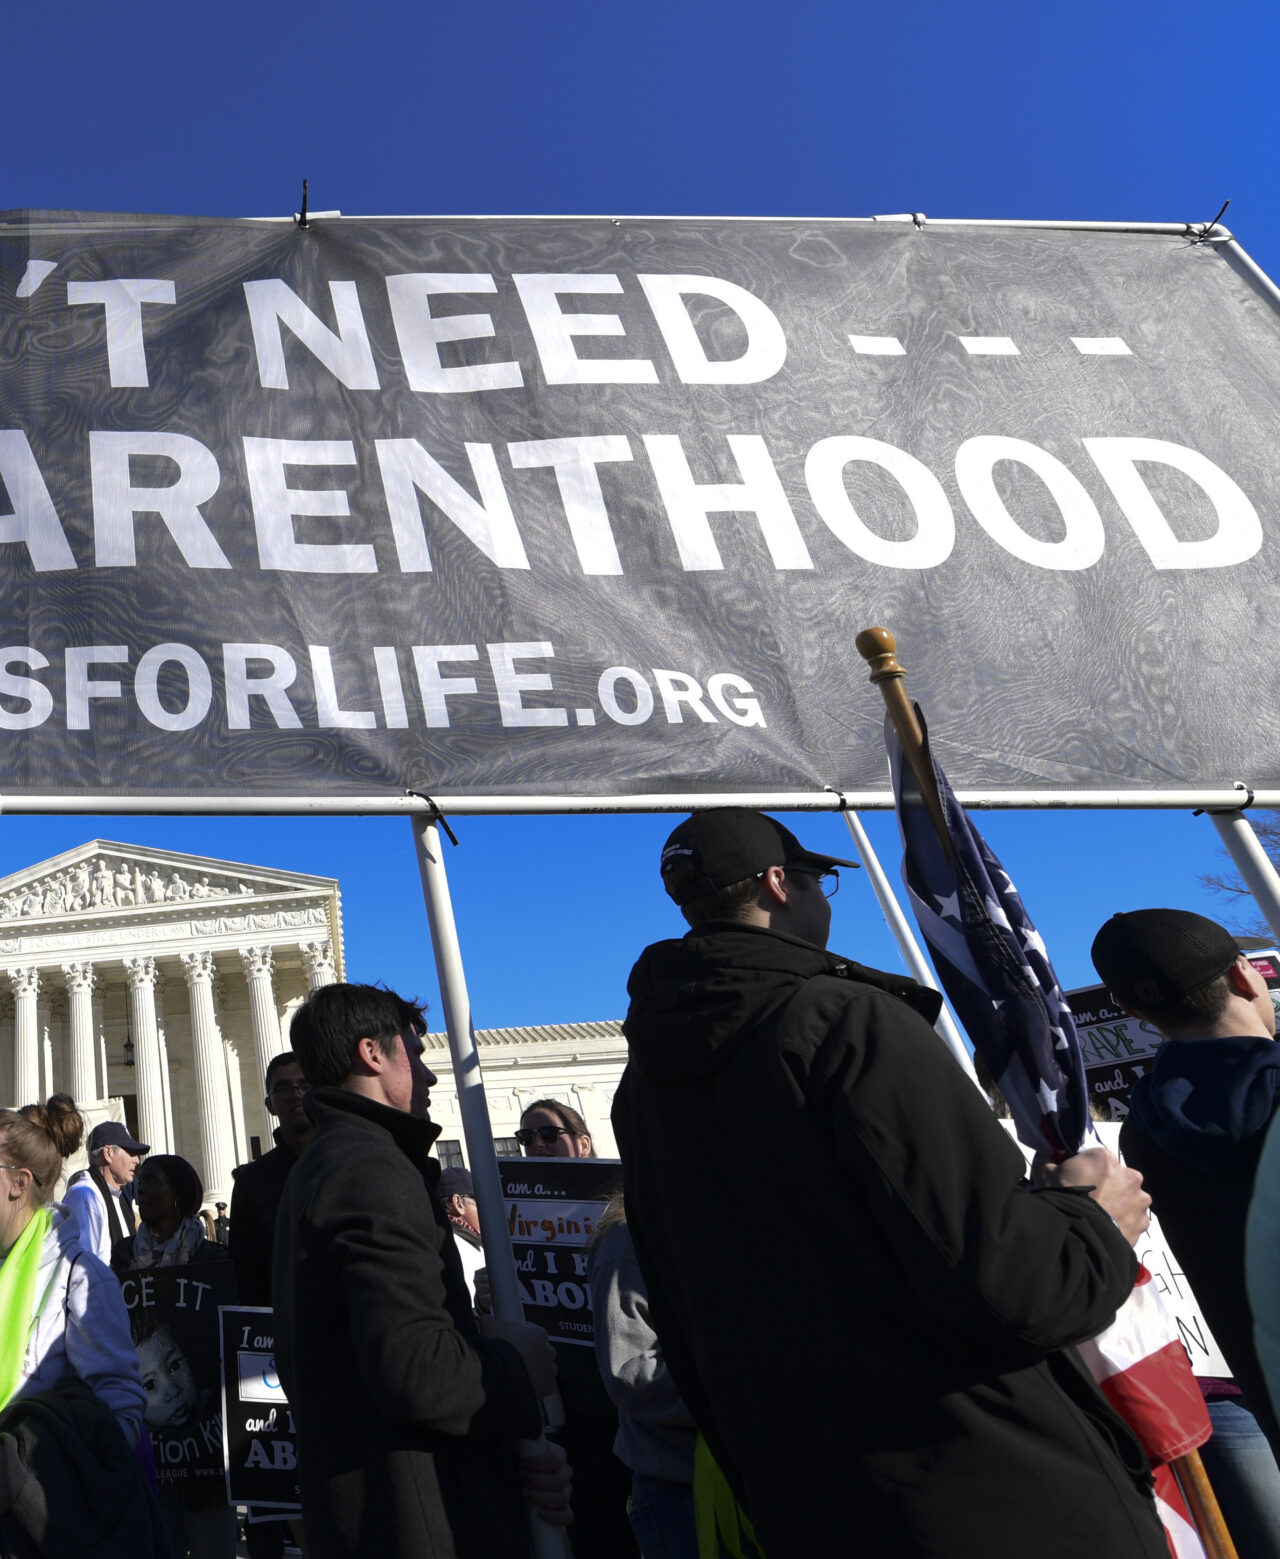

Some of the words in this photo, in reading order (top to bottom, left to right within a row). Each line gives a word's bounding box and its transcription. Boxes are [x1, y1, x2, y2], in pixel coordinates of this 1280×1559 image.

[244, 272, 787, 393] NEED
[1095, 1068, 1129, 1093] and
[506, 1181, 532, 1195] am
[507, 1203, 593, 1242] Virgini
[514, 1249, 537, 1273] nd
[544, 1251, 560, 1275] I
[121, 1275, 157, 1311] CE
[174, 1277, 212, 1312] IT
[241, 1325, 252, 1348] I
[245, 1407, 278, 1433] and
